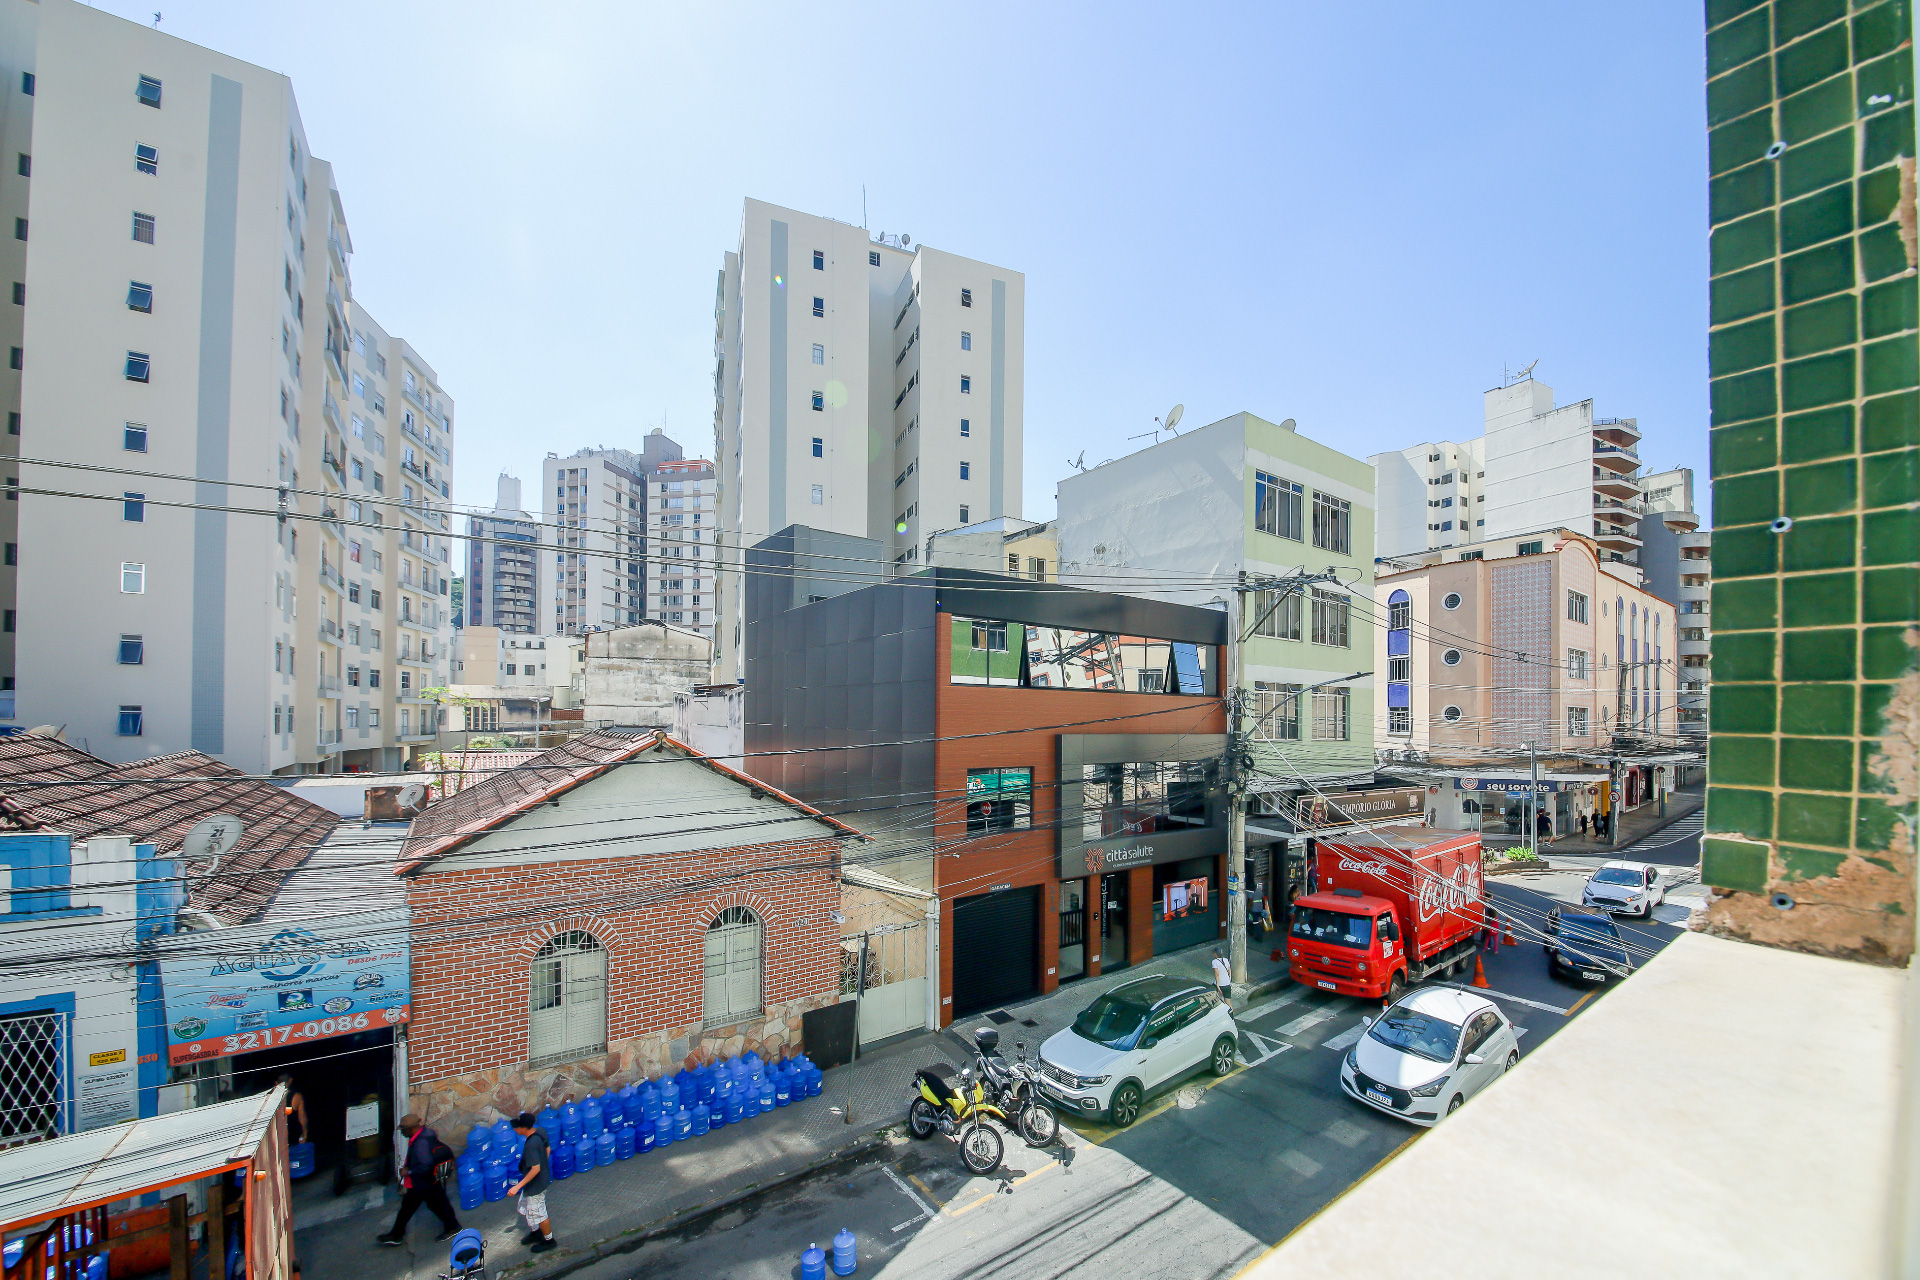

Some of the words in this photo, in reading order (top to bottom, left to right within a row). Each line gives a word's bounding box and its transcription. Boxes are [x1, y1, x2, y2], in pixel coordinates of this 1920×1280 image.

[1487, 783, 1505, 791] seu
[1341, 800, 1371, 814] EMPÓRIO
[1372, 798, 1396, 811] GLÓRIA
[210, 829, 225, 837] 21
[1339, 857, 1388, 876] Coca-Cola
[305, 974, 341, 984] marcas
[223, 1012, 369, 1053] 3217-0086
[173, 1049, 219, 1064] SUPERGASBRAS
